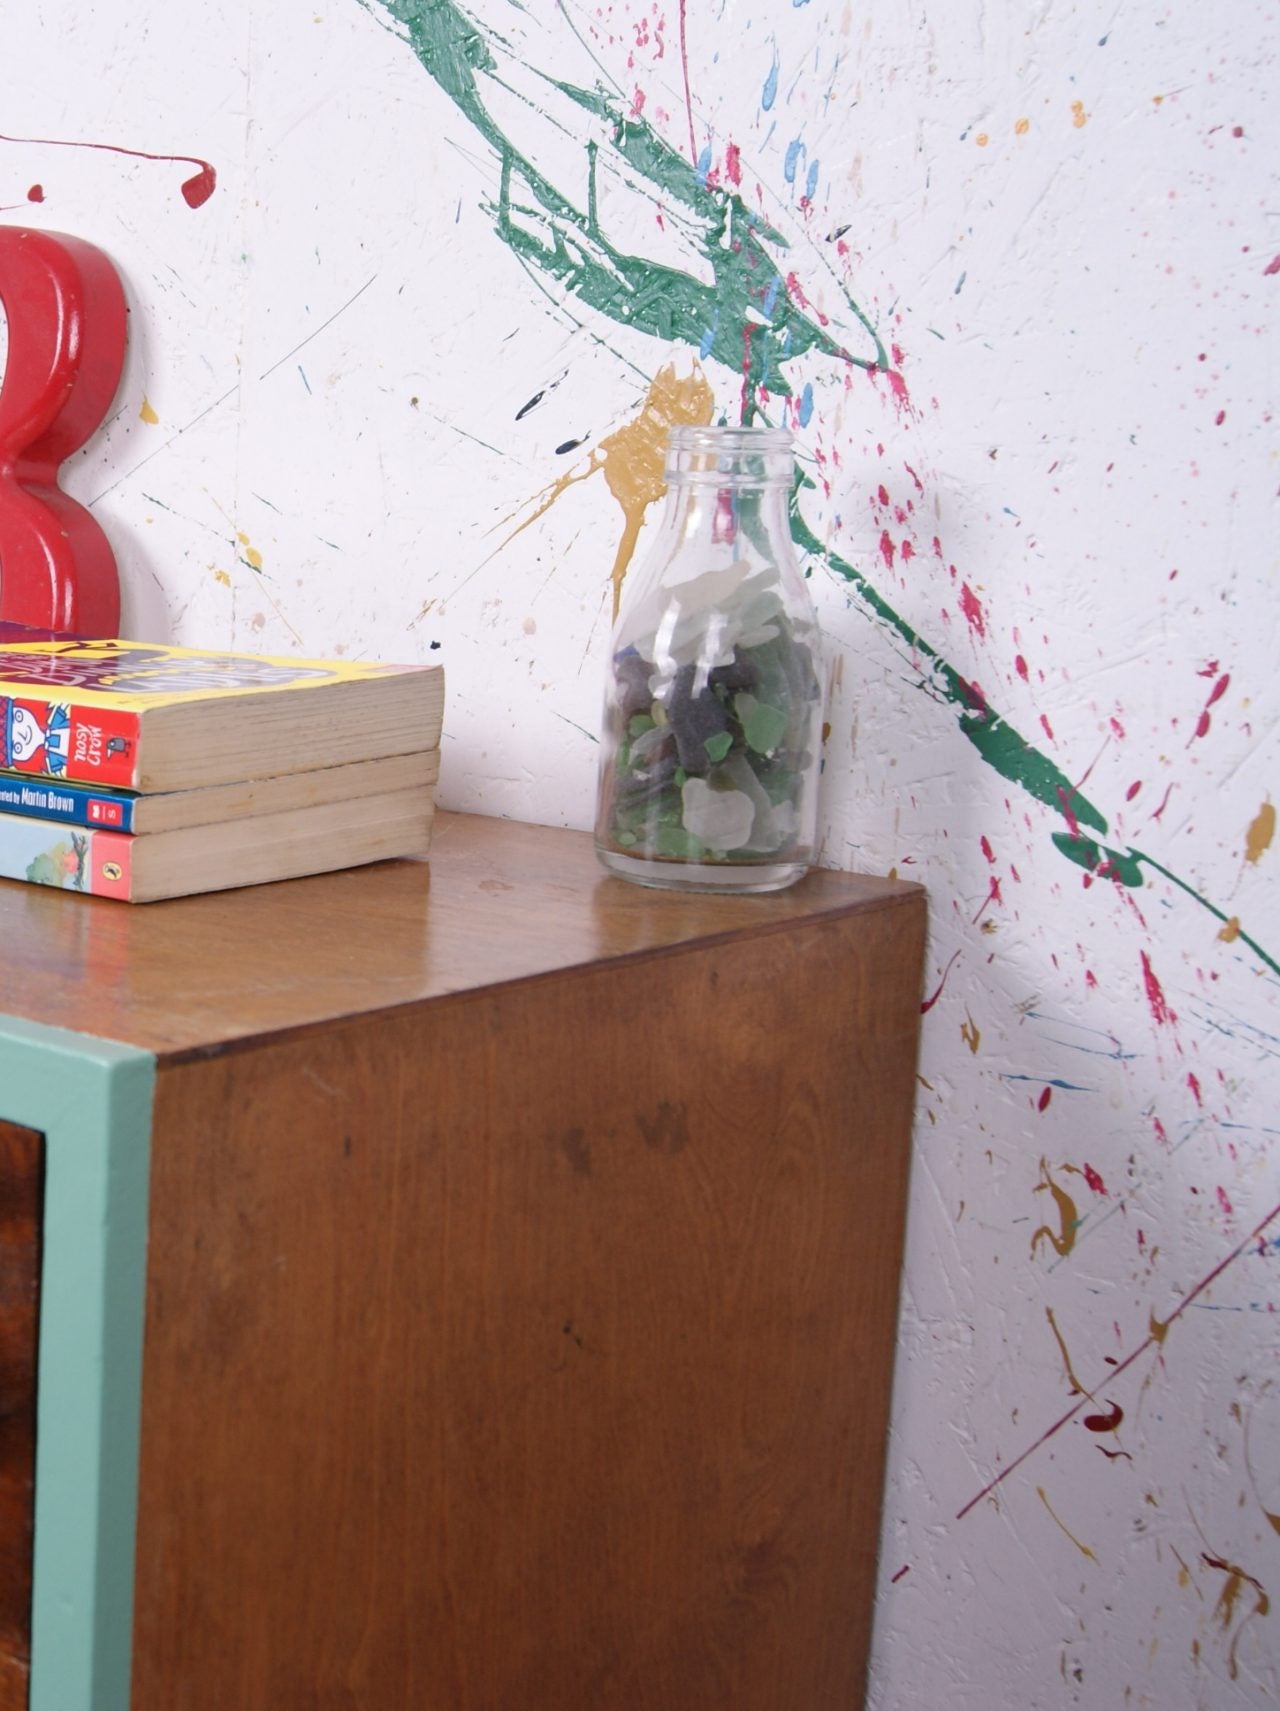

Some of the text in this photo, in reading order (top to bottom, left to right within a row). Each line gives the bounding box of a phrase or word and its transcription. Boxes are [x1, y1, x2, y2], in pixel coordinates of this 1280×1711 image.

[74, 723, 90, 762] nosy
[21, 787, 47, 808] Martin
[48, 791, 74, 812] Brown
